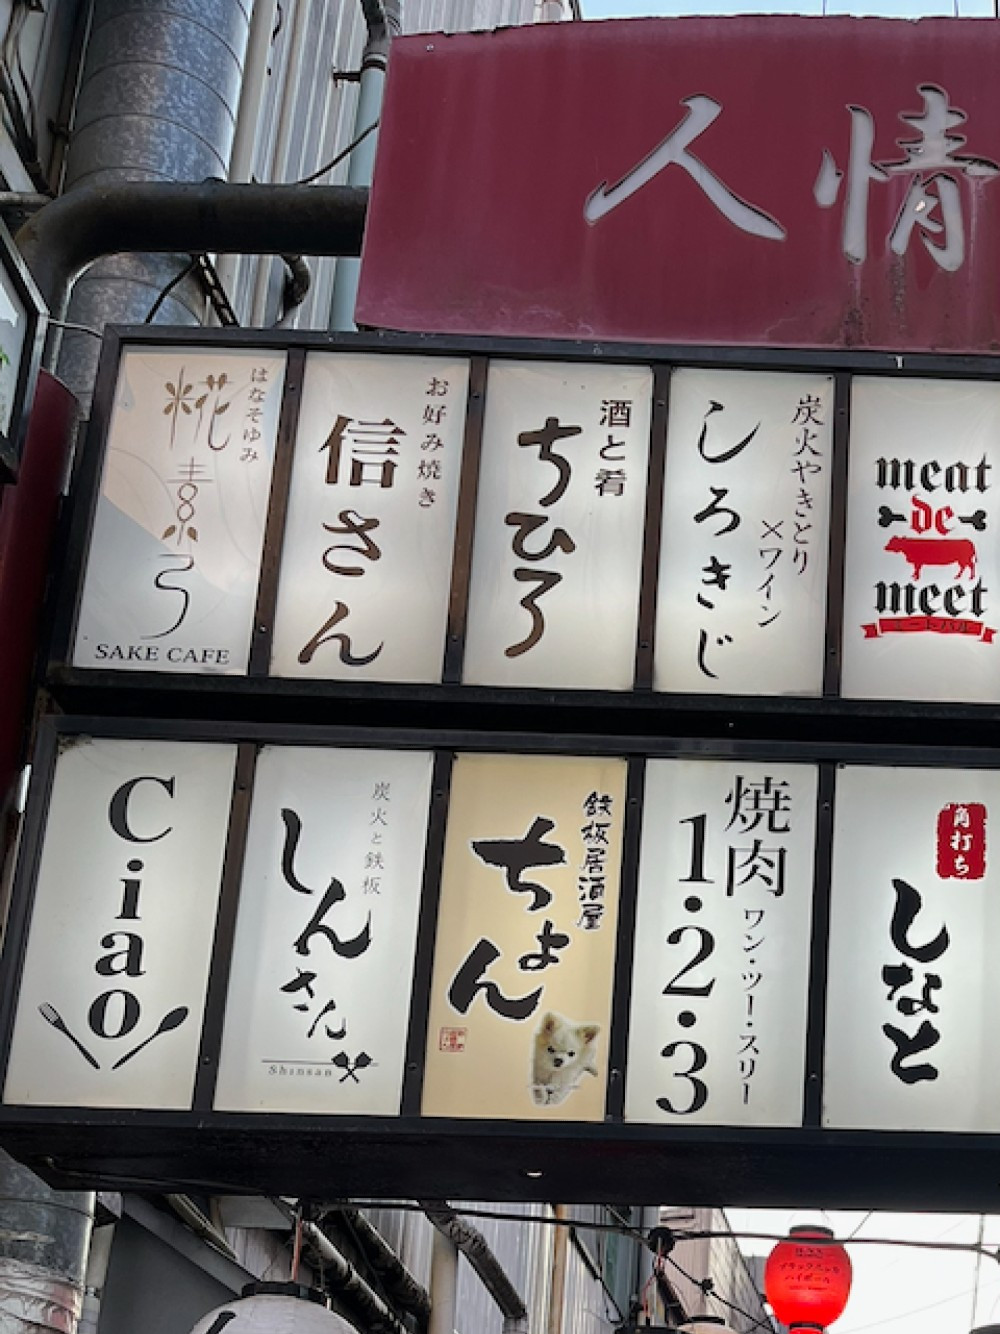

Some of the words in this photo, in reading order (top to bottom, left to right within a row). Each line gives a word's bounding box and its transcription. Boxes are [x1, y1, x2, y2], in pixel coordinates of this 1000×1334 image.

[416, 376, 449, 509] お好み焼き
[594, 399, 632, 498] 酒と肴
[790, 393, 826, 576] 炭火やきとり
[874, 452, 993, 494] meat
[297, 414, 407, 666] 信さん
[504, 417, 583, 658] ちひろ
[693, 400, 762, 680] しろきじ
[909, 494, 954, 535] de
[94, 643, 159, 662] SAKE
[166, 646, 230, 665] CAFE
[874, 578, 989, 617] meet
[361, 781, 391, 896] 炭火と鉄板
[576, 791, 614, 931] 鉄板居酒屋
[724, 775, 792, 898] 焼肉
[949, 806, 974, 876] 角打ち
[87, 776, 176, 1039] Ciao
[280, 807, 373, 1040] しんさん
[447, 815, 571, 1021] ちょん
[881, 878, 950, 1085] しなと
[268, 1064, 332, 1077] Shinsan
